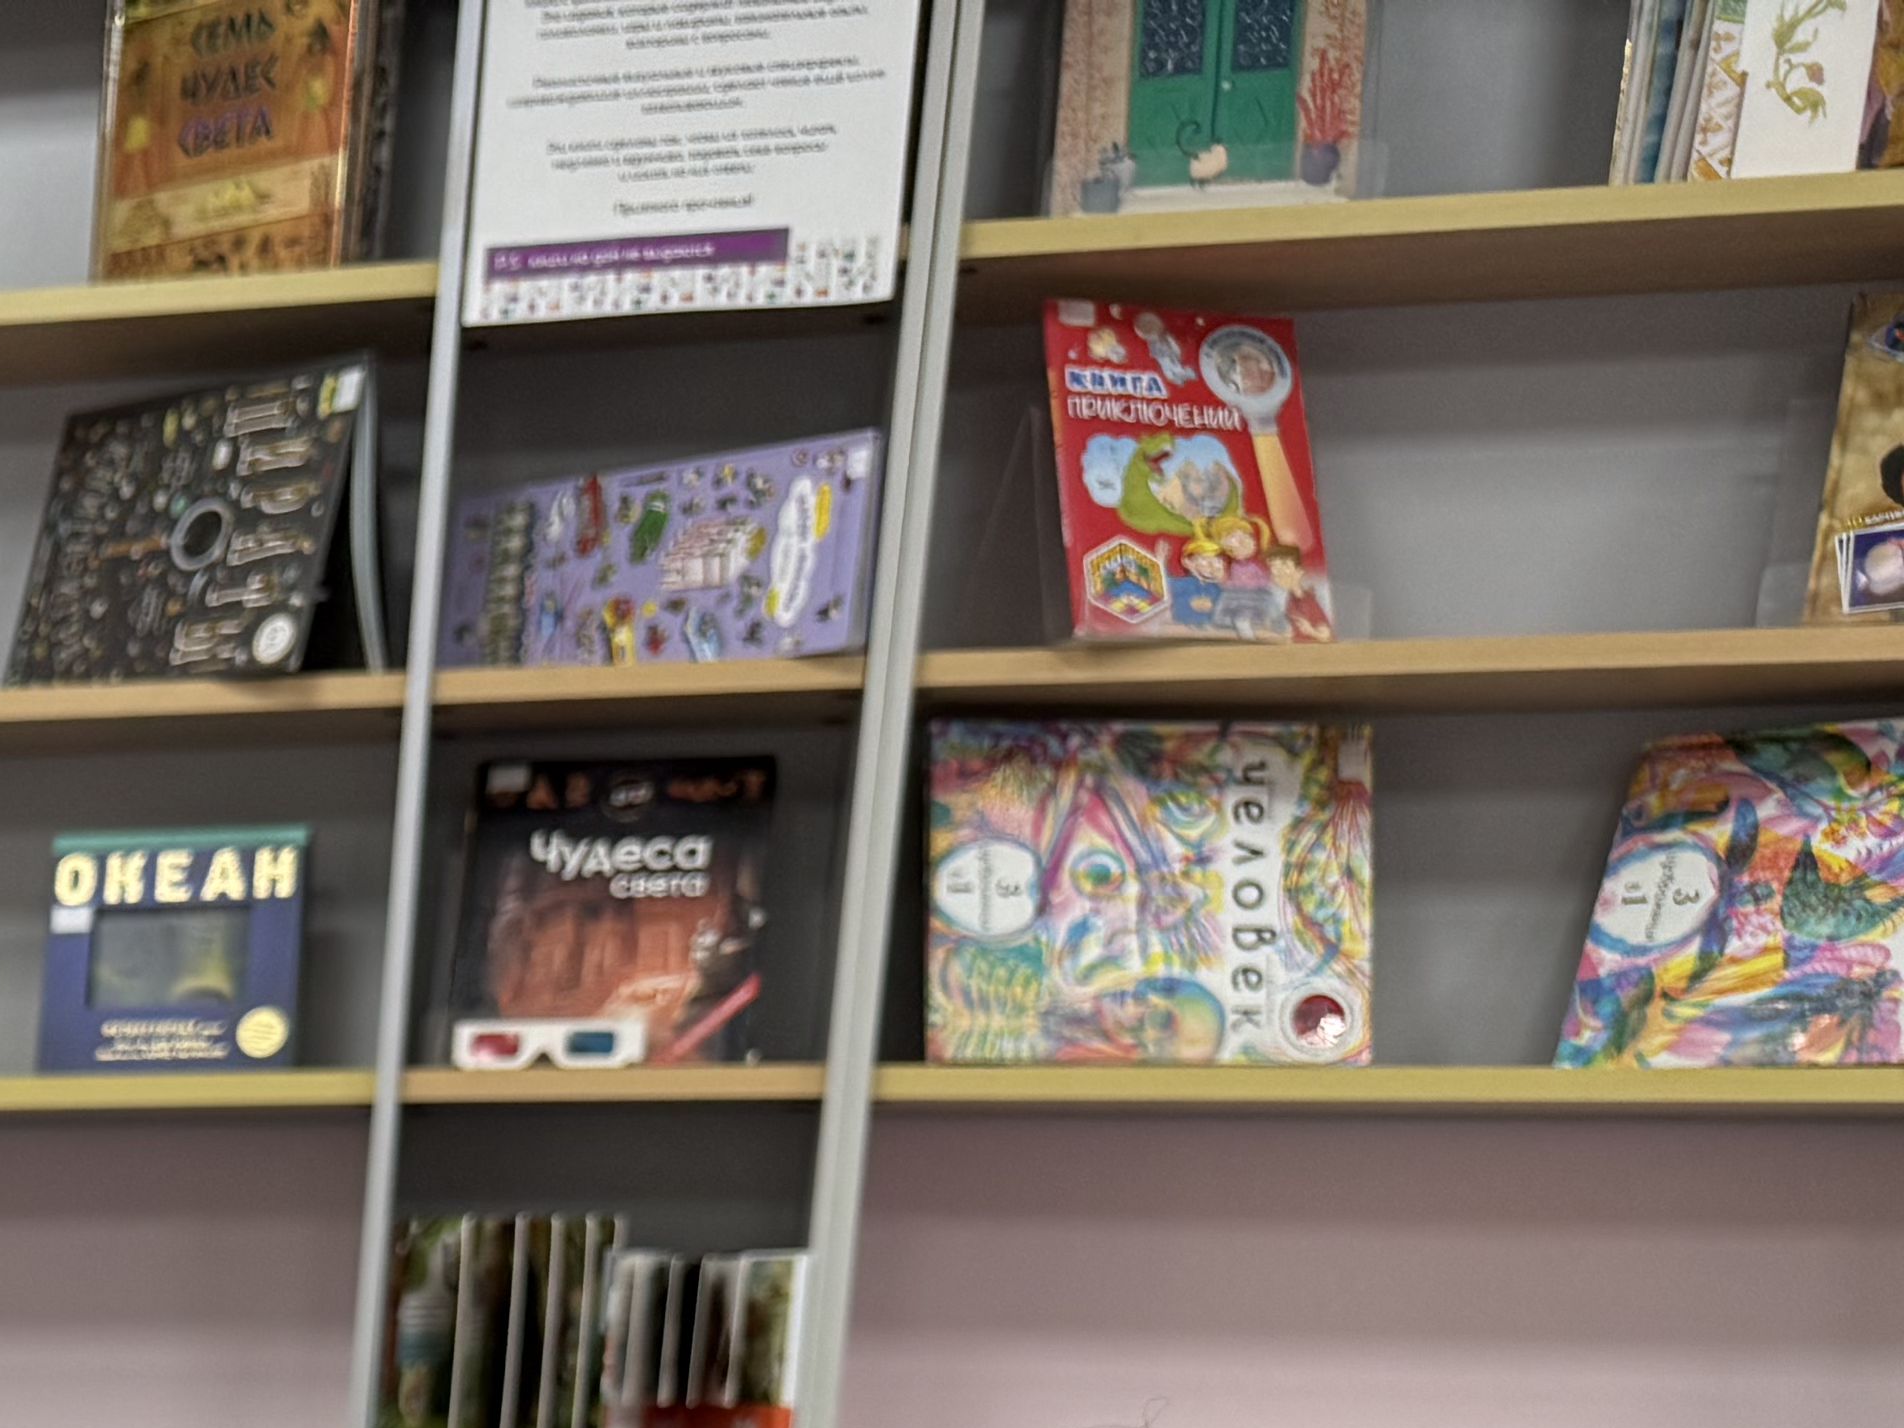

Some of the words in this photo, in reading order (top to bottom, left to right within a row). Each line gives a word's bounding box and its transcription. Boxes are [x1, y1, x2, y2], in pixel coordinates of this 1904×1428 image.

[182, 54, 279, 104] ЧУДЕС
[177, 105, 273, 157] СВЕТА
[1068, 369, 1164, 394] КНИГА
[54, 845, 298, 906] ОКЕАН
[529, 828, 713, 880] Чудеса
[609, 870, 710, 898] света
